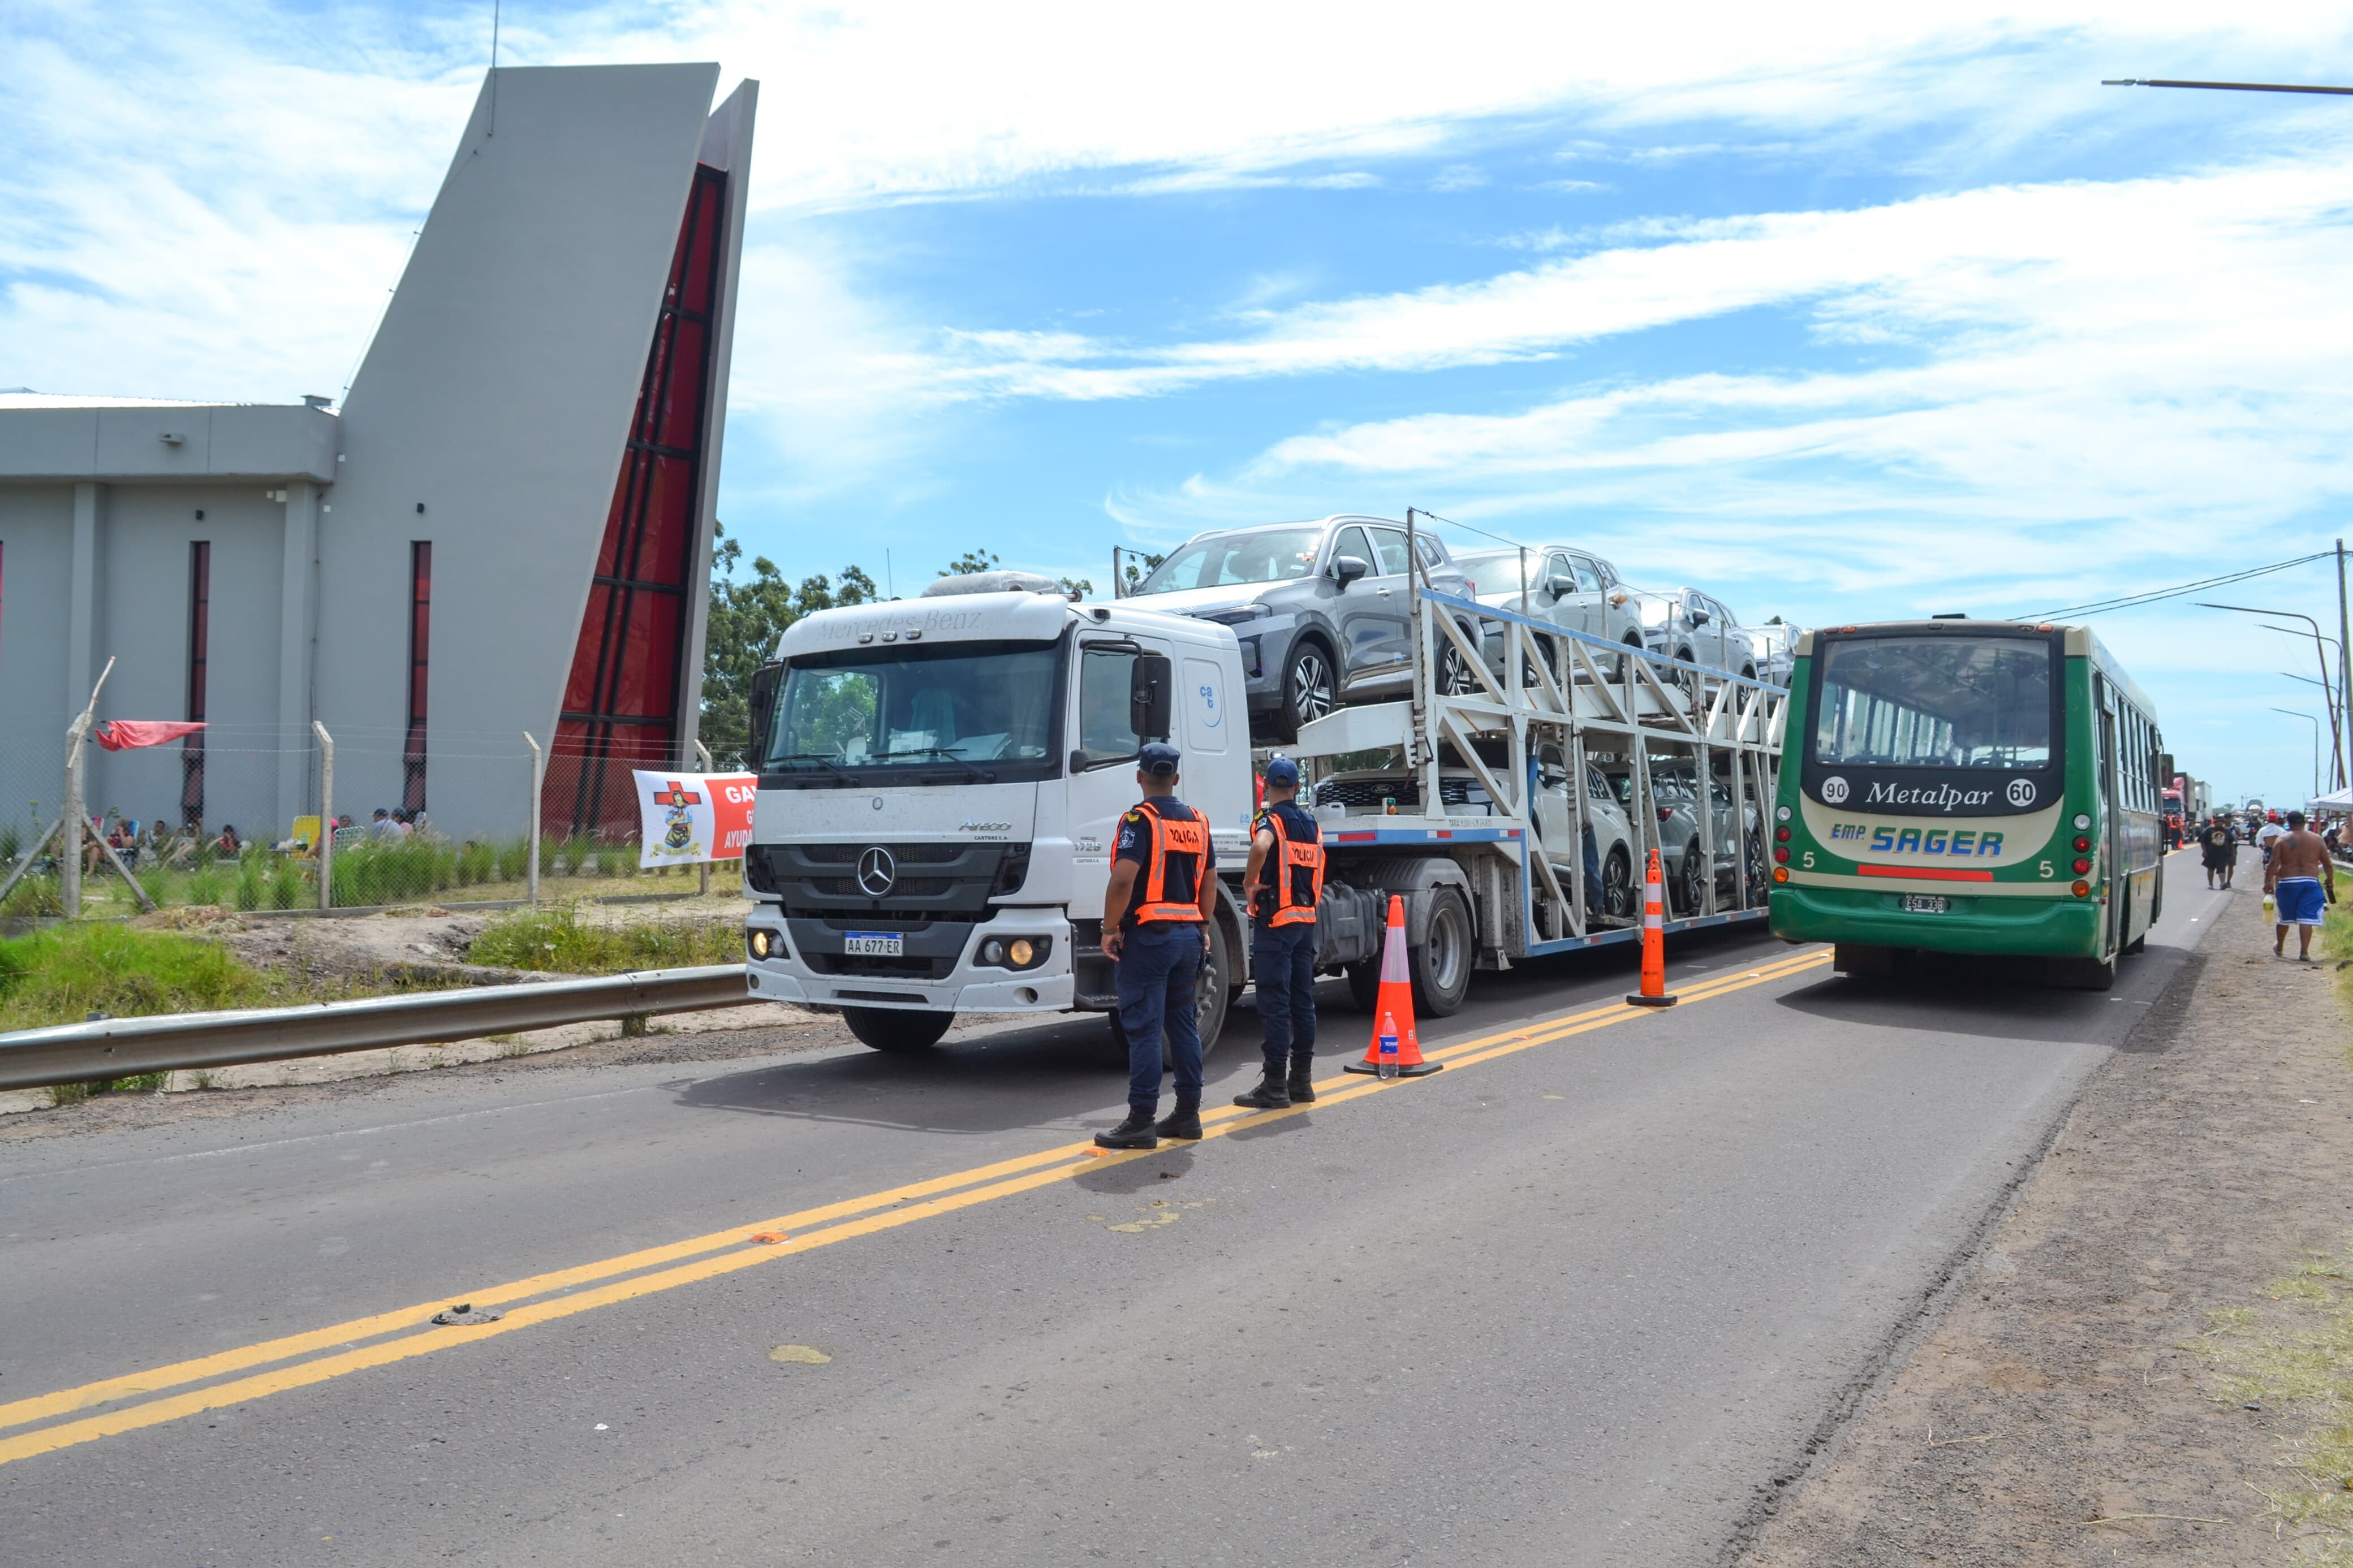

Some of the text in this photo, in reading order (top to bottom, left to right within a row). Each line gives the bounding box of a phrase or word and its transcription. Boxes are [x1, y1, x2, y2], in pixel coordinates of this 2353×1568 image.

[1826, 783, 1845, 798] 90
[1865, 782, 1993, 811] Metalpar
[2009, 783, 2033, 801] 60
[1869, 827, 2005, 857] SAGER
[1803, 851, 1815, 869] 5
[2039, 860, 2054, 878] 5
[1906, 899, 1943, 910] ESA 338
[848, 939, 899, 954] AA 677 ER
